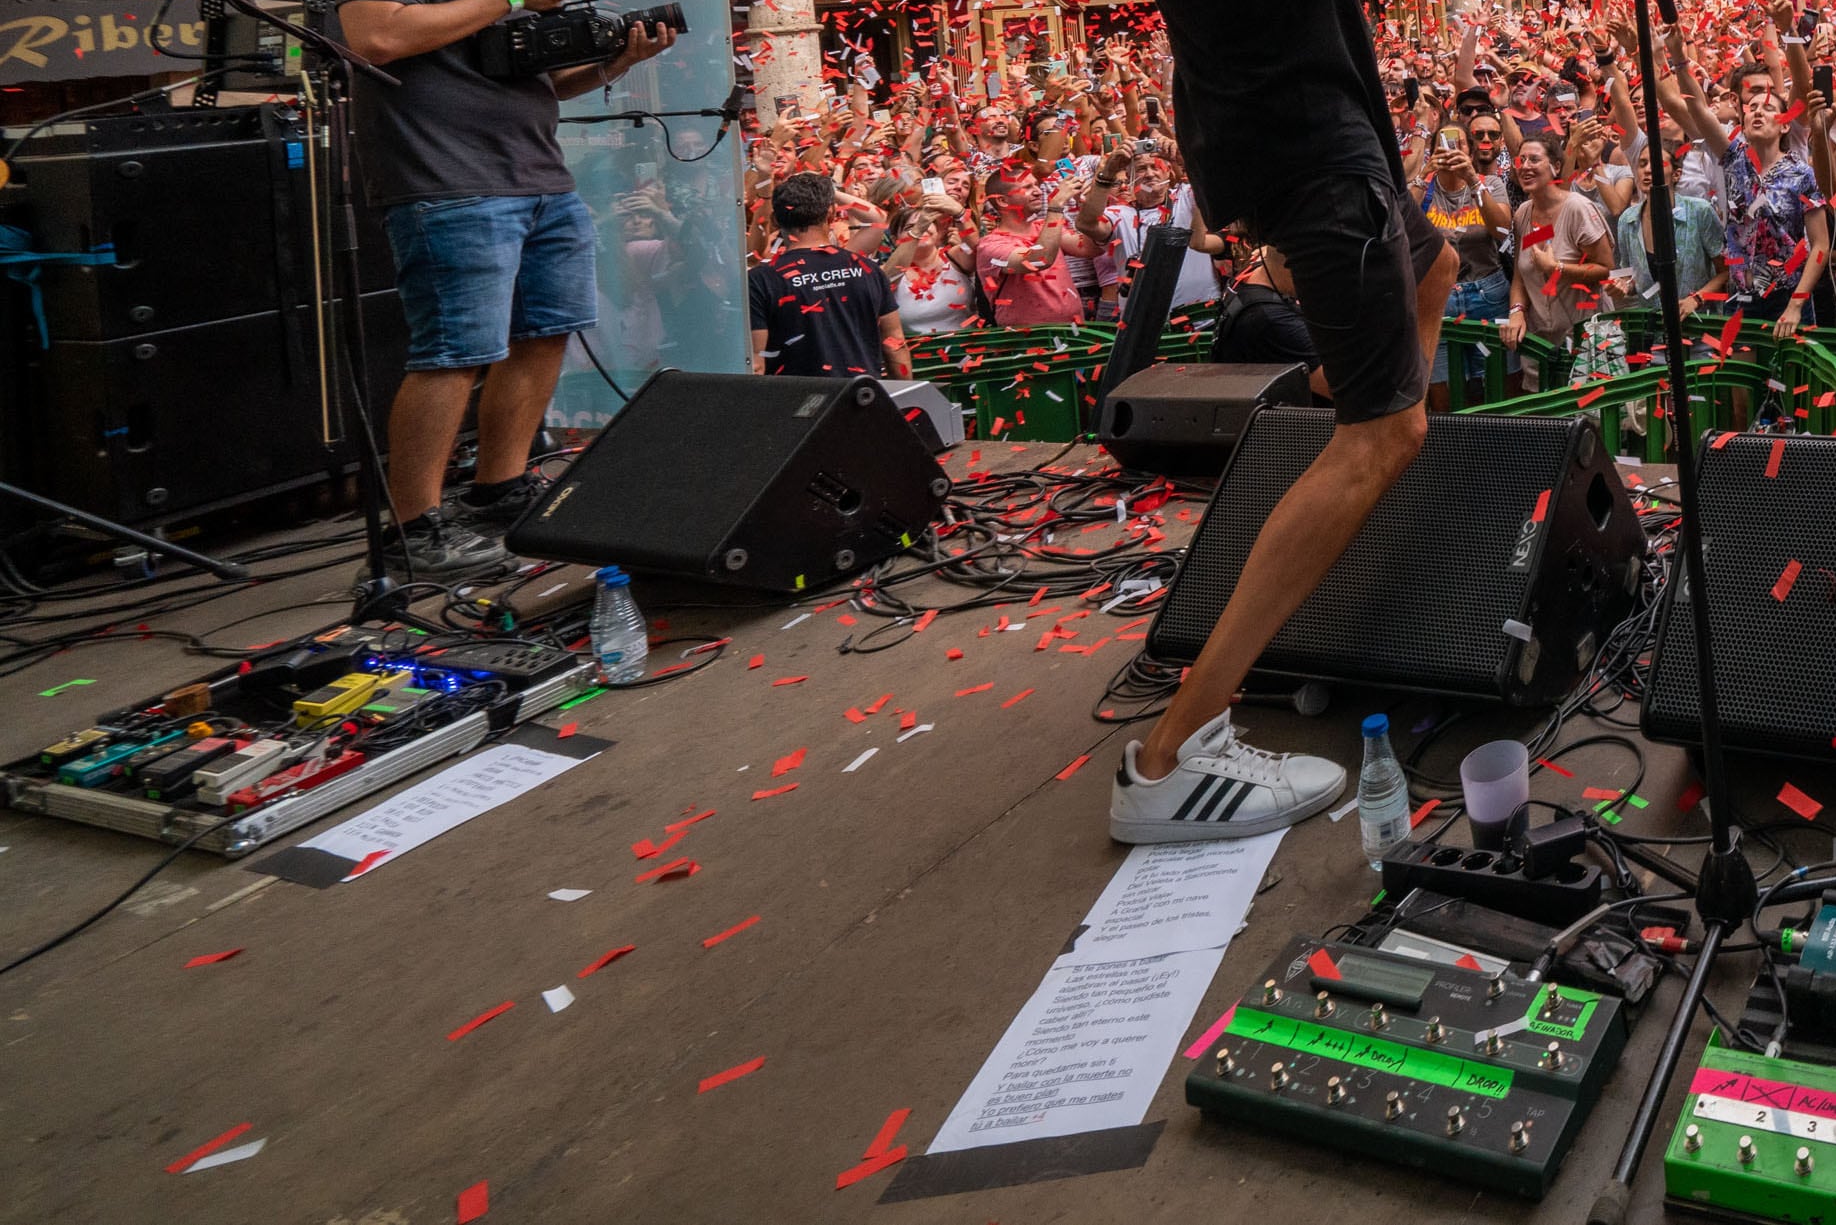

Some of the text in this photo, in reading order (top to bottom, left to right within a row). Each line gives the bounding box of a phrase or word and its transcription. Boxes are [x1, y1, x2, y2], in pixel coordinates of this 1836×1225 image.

[0, 16, 206, 69] Riber
[792, 267, 863, 288] SFX CREW
[1130, 967, 1150, 976] nos
[1091, 989, 1108, 998] tan
[1071, 1020, 1089, 1030] tan
[1090, 1016, 1125, 1026] eterno
[1126, 1013, 1150, 1022] este
[1529, 1021, 1575, 1039] AFINADOR
[1060, 1042, 1078, 1052] me
[1080, 1039, 1101, 1049] voy
[1111, 1034, 1148, 1046] querer
[1032, 1061, 1089, 1078] quedarme
[1089, 1059, 1107, 1069] sin
[1299, 1056, 1321, 1075] 2
[1006, 1079, 1039, 1091] bailar
[1040, 1076, 1062, 1087] con
[1063, 1073, 1075, 1083] la
[1076, 1068, 1116, 1081] muerte
[1117, 1067, 1134, 1077] no
[1357, 1069, 1378, 1089] 3
[986, 1087, 1060, 1107] es buen plan
[1044, 1097, 1067, 1110] que
[1068, 1095, 1089, 1104] me
[1089, 1090, 1126, 1103] mates
[1417, 1084, 1436, 1104] 4
[1477, 1097, 1494, 1119] 5
[995, 1115, 1028, 1127] bailar
[1754, 1110, 1818, 1133] 2 3
